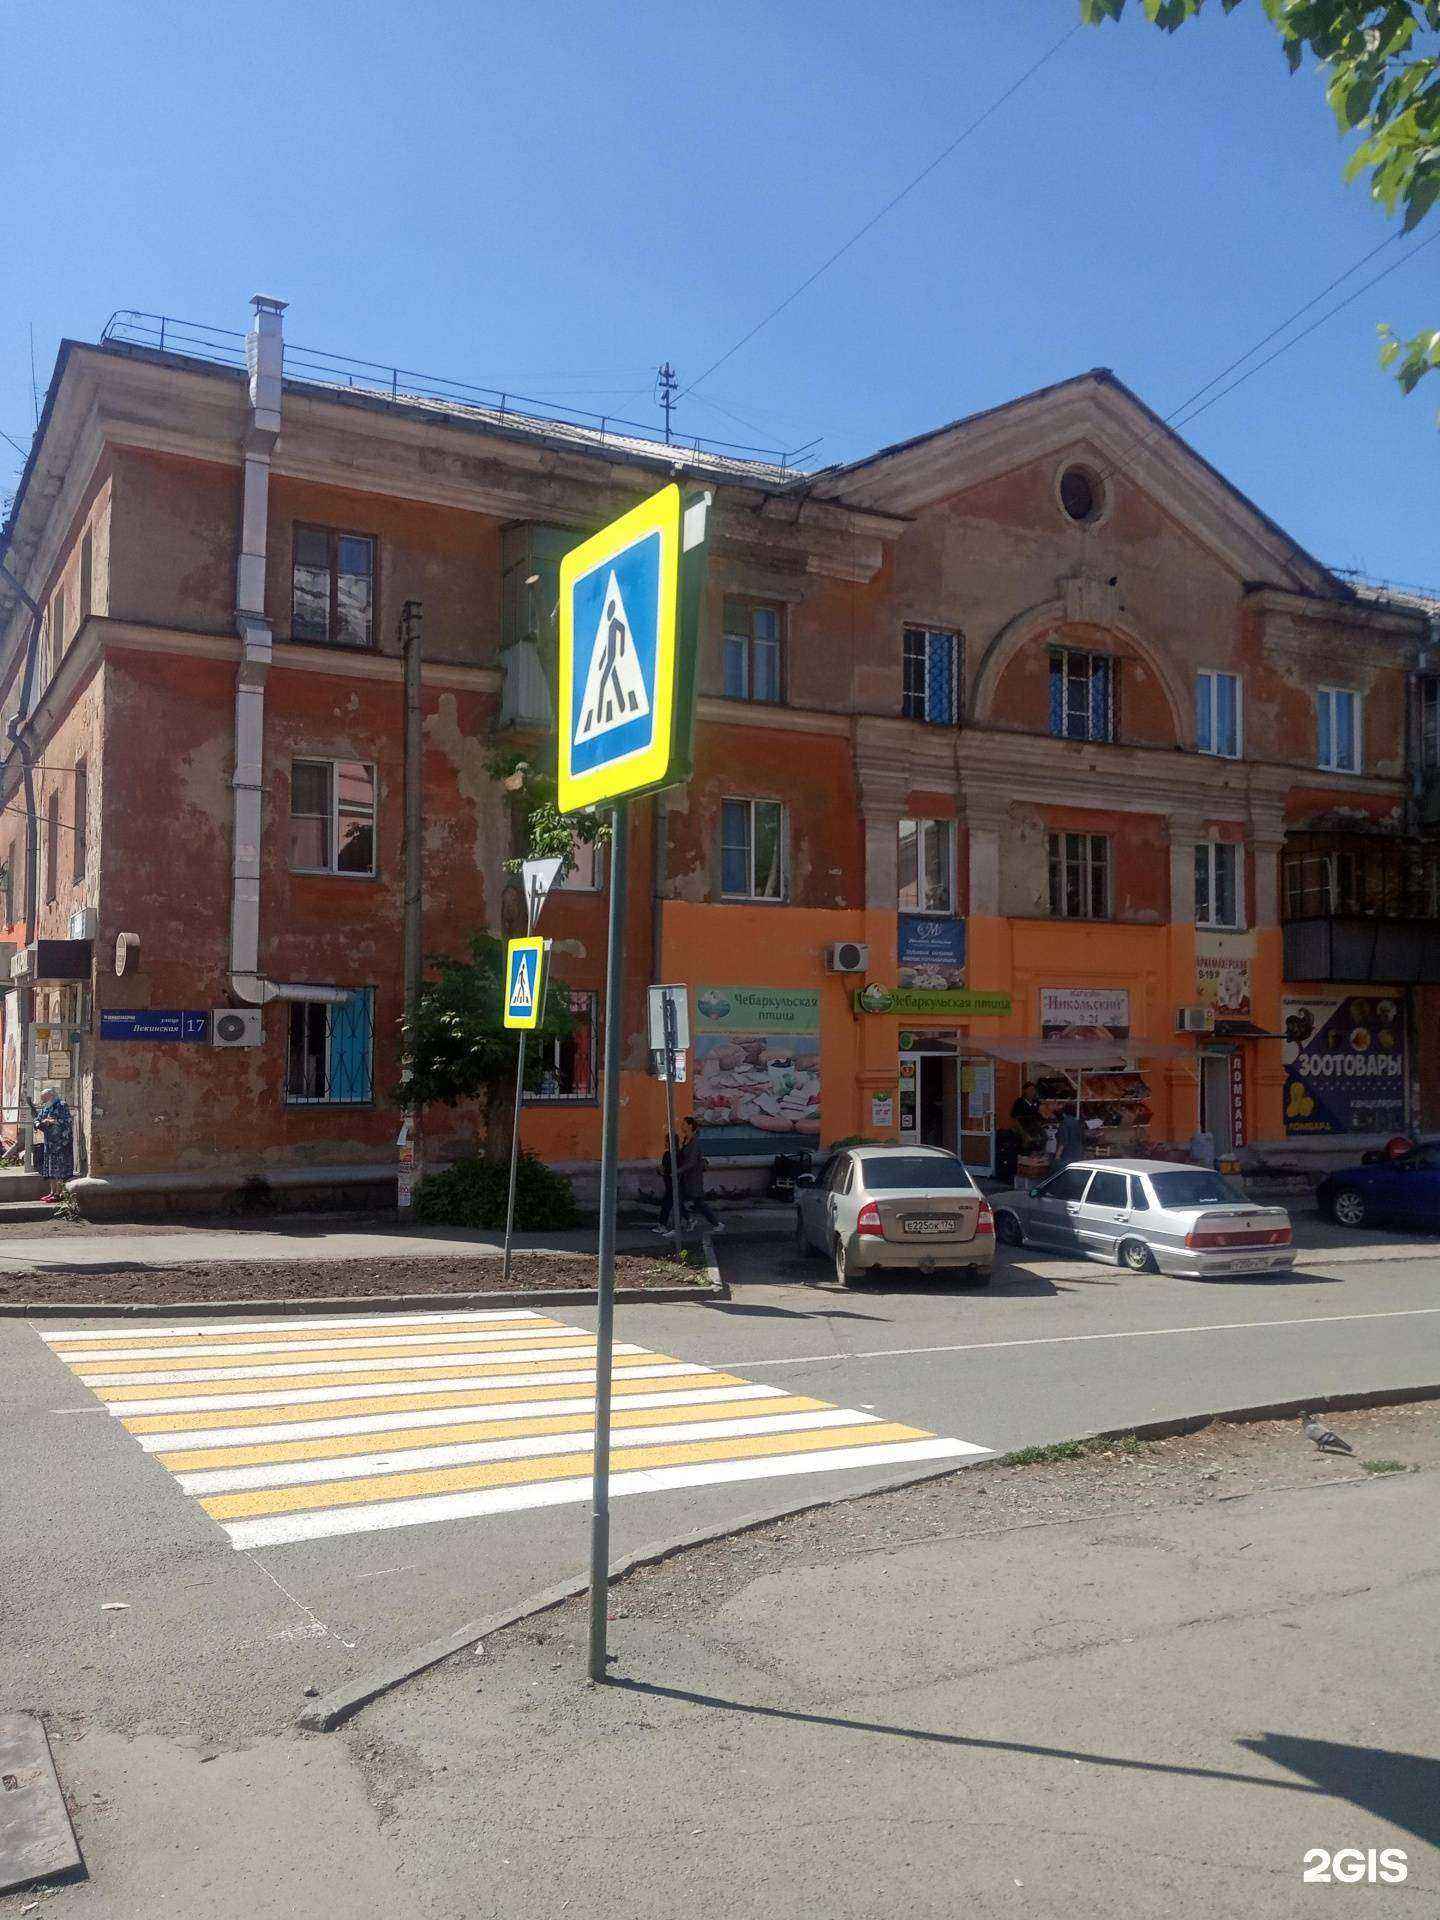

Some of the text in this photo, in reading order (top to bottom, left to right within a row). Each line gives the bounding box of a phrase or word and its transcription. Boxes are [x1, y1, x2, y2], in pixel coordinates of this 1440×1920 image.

[734, 993, 818, 1009] Чебаркульская
[758, 1010, 795, 1021] птица
[133, 1019, 205, 1033] Пекинская 17
[1299, 1054, 1402, 1076] ЗООТОВАРЫ
